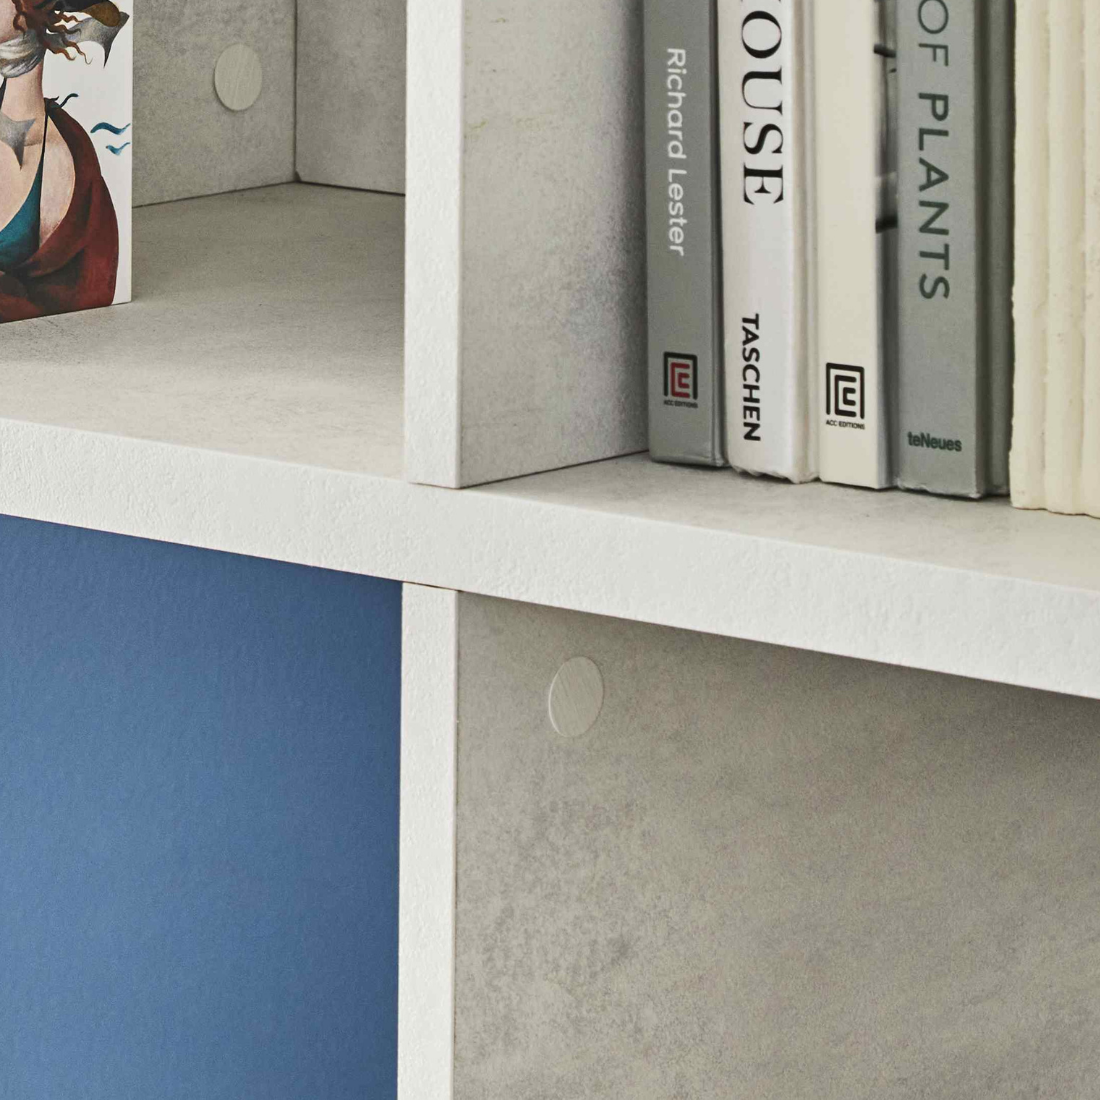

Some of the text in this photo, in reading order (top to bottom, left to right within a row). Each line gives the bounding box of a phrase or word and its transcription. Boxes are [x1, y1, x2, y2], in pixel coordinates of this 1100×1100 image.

[667, 48, 688, 256] Richard Lester
[918, 92, 950, 299] PLANTS
[742, 313, 761, 441] TASCHEN
[838, 421, 866, 430] EDITIONS
[907, 431, 962, 452] teNeues
